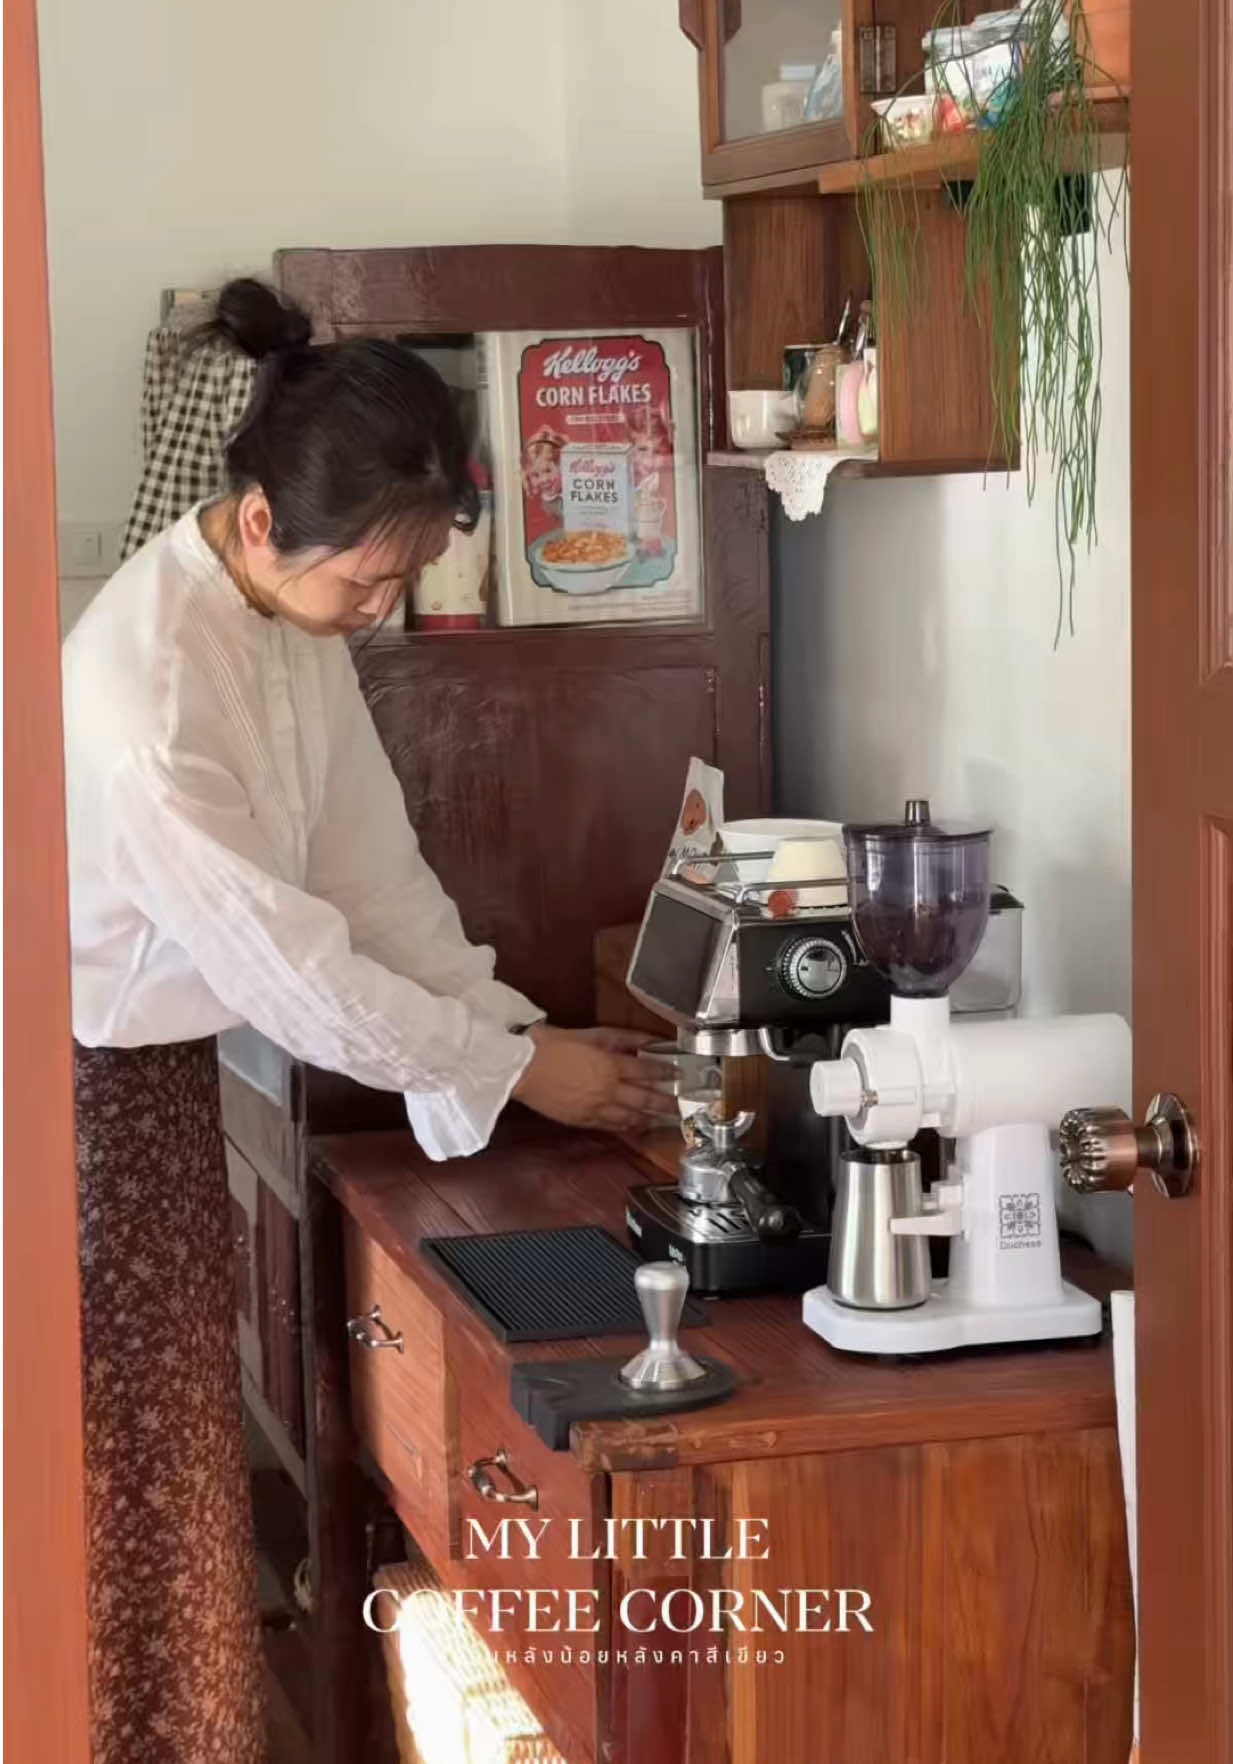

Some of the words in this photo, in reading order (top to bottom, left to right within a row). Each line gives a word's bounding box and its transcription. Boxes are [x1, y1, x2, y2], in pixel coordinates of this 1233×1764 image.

[543, 345, 643, 382] Kellogg's
[536, 387, 584, 408] CORN
[588, 383, 652, 405] FLAKES
[572, 478, 615, 491] CORN
[570, 490, 619, 504] FLAKES
